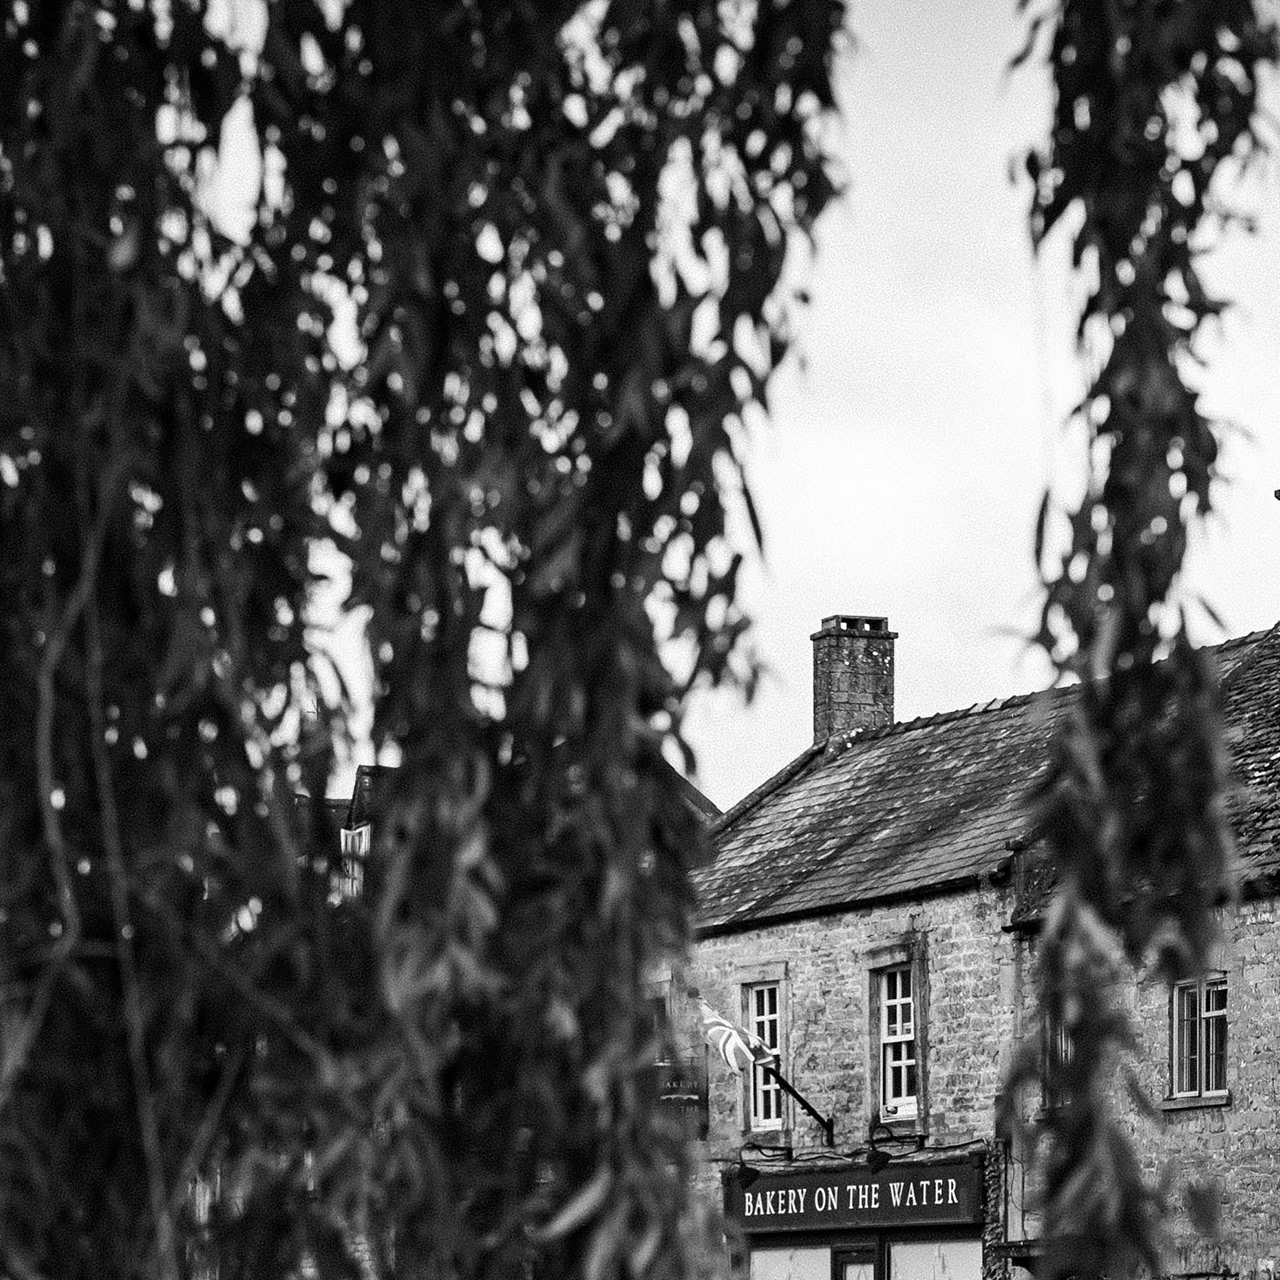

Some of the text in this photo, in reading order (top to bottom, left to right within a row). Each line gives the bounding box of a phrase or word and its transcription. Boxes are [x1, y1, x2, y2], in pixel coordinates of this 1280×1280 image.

[744, 1178, 959, 1216] BAKERY ON THE WATER
